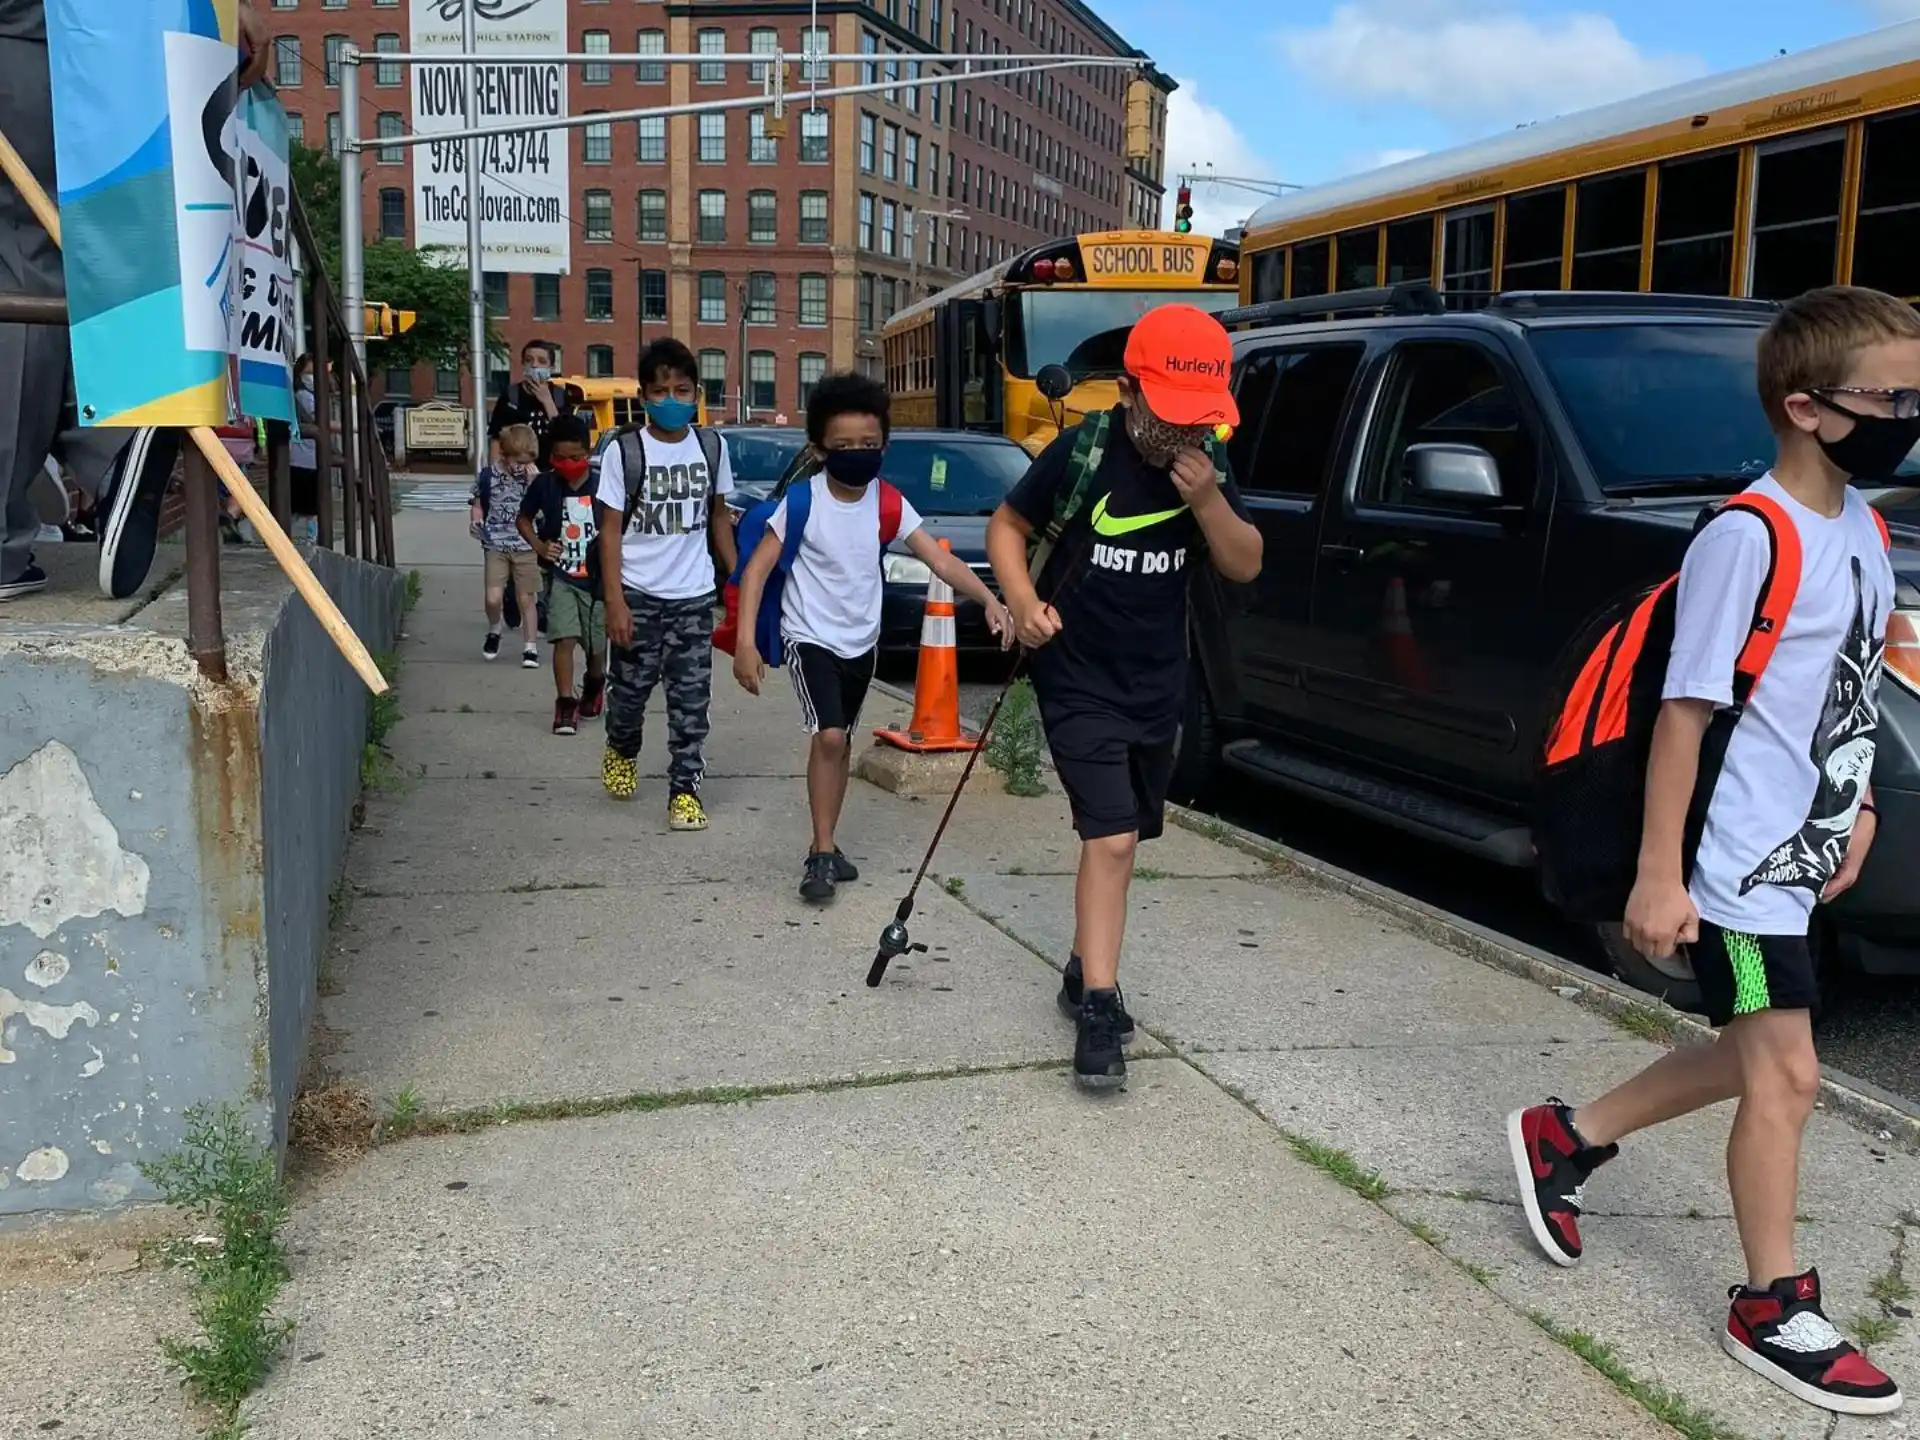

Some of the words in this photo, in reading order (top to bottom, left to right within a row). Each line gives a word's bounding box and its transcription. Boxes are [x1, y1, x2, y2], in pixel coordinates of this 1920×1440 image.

[425, 35, 437, 43] AT
[441, 33, 502, 43] HAVHILL
[506, 33, 551, 42] STATION
[419, 66, 466, 116] NOW
[475, 65, 559, 116] RENTING
[430, 132, 550, 174] 978.74.3744
[422, 185, 560, 223] TheCodovan.com
[514, 246, 551, 254] LIVING
[1093, 246, 1159, 273] SCHOOL
[1162, 247, 1194, 273] BUS
[1165, 355, 1214, 376] Hurley
[644, 462, 708, 501] BOS
[1090, 543, 1137, 573] JUST
[1141, 551, 1169, 574] DO
[1174, 548, 1186, 571] IT
[1835, 680, 1853, 701] 19
[1769, 843, 1794, 868] SURF
